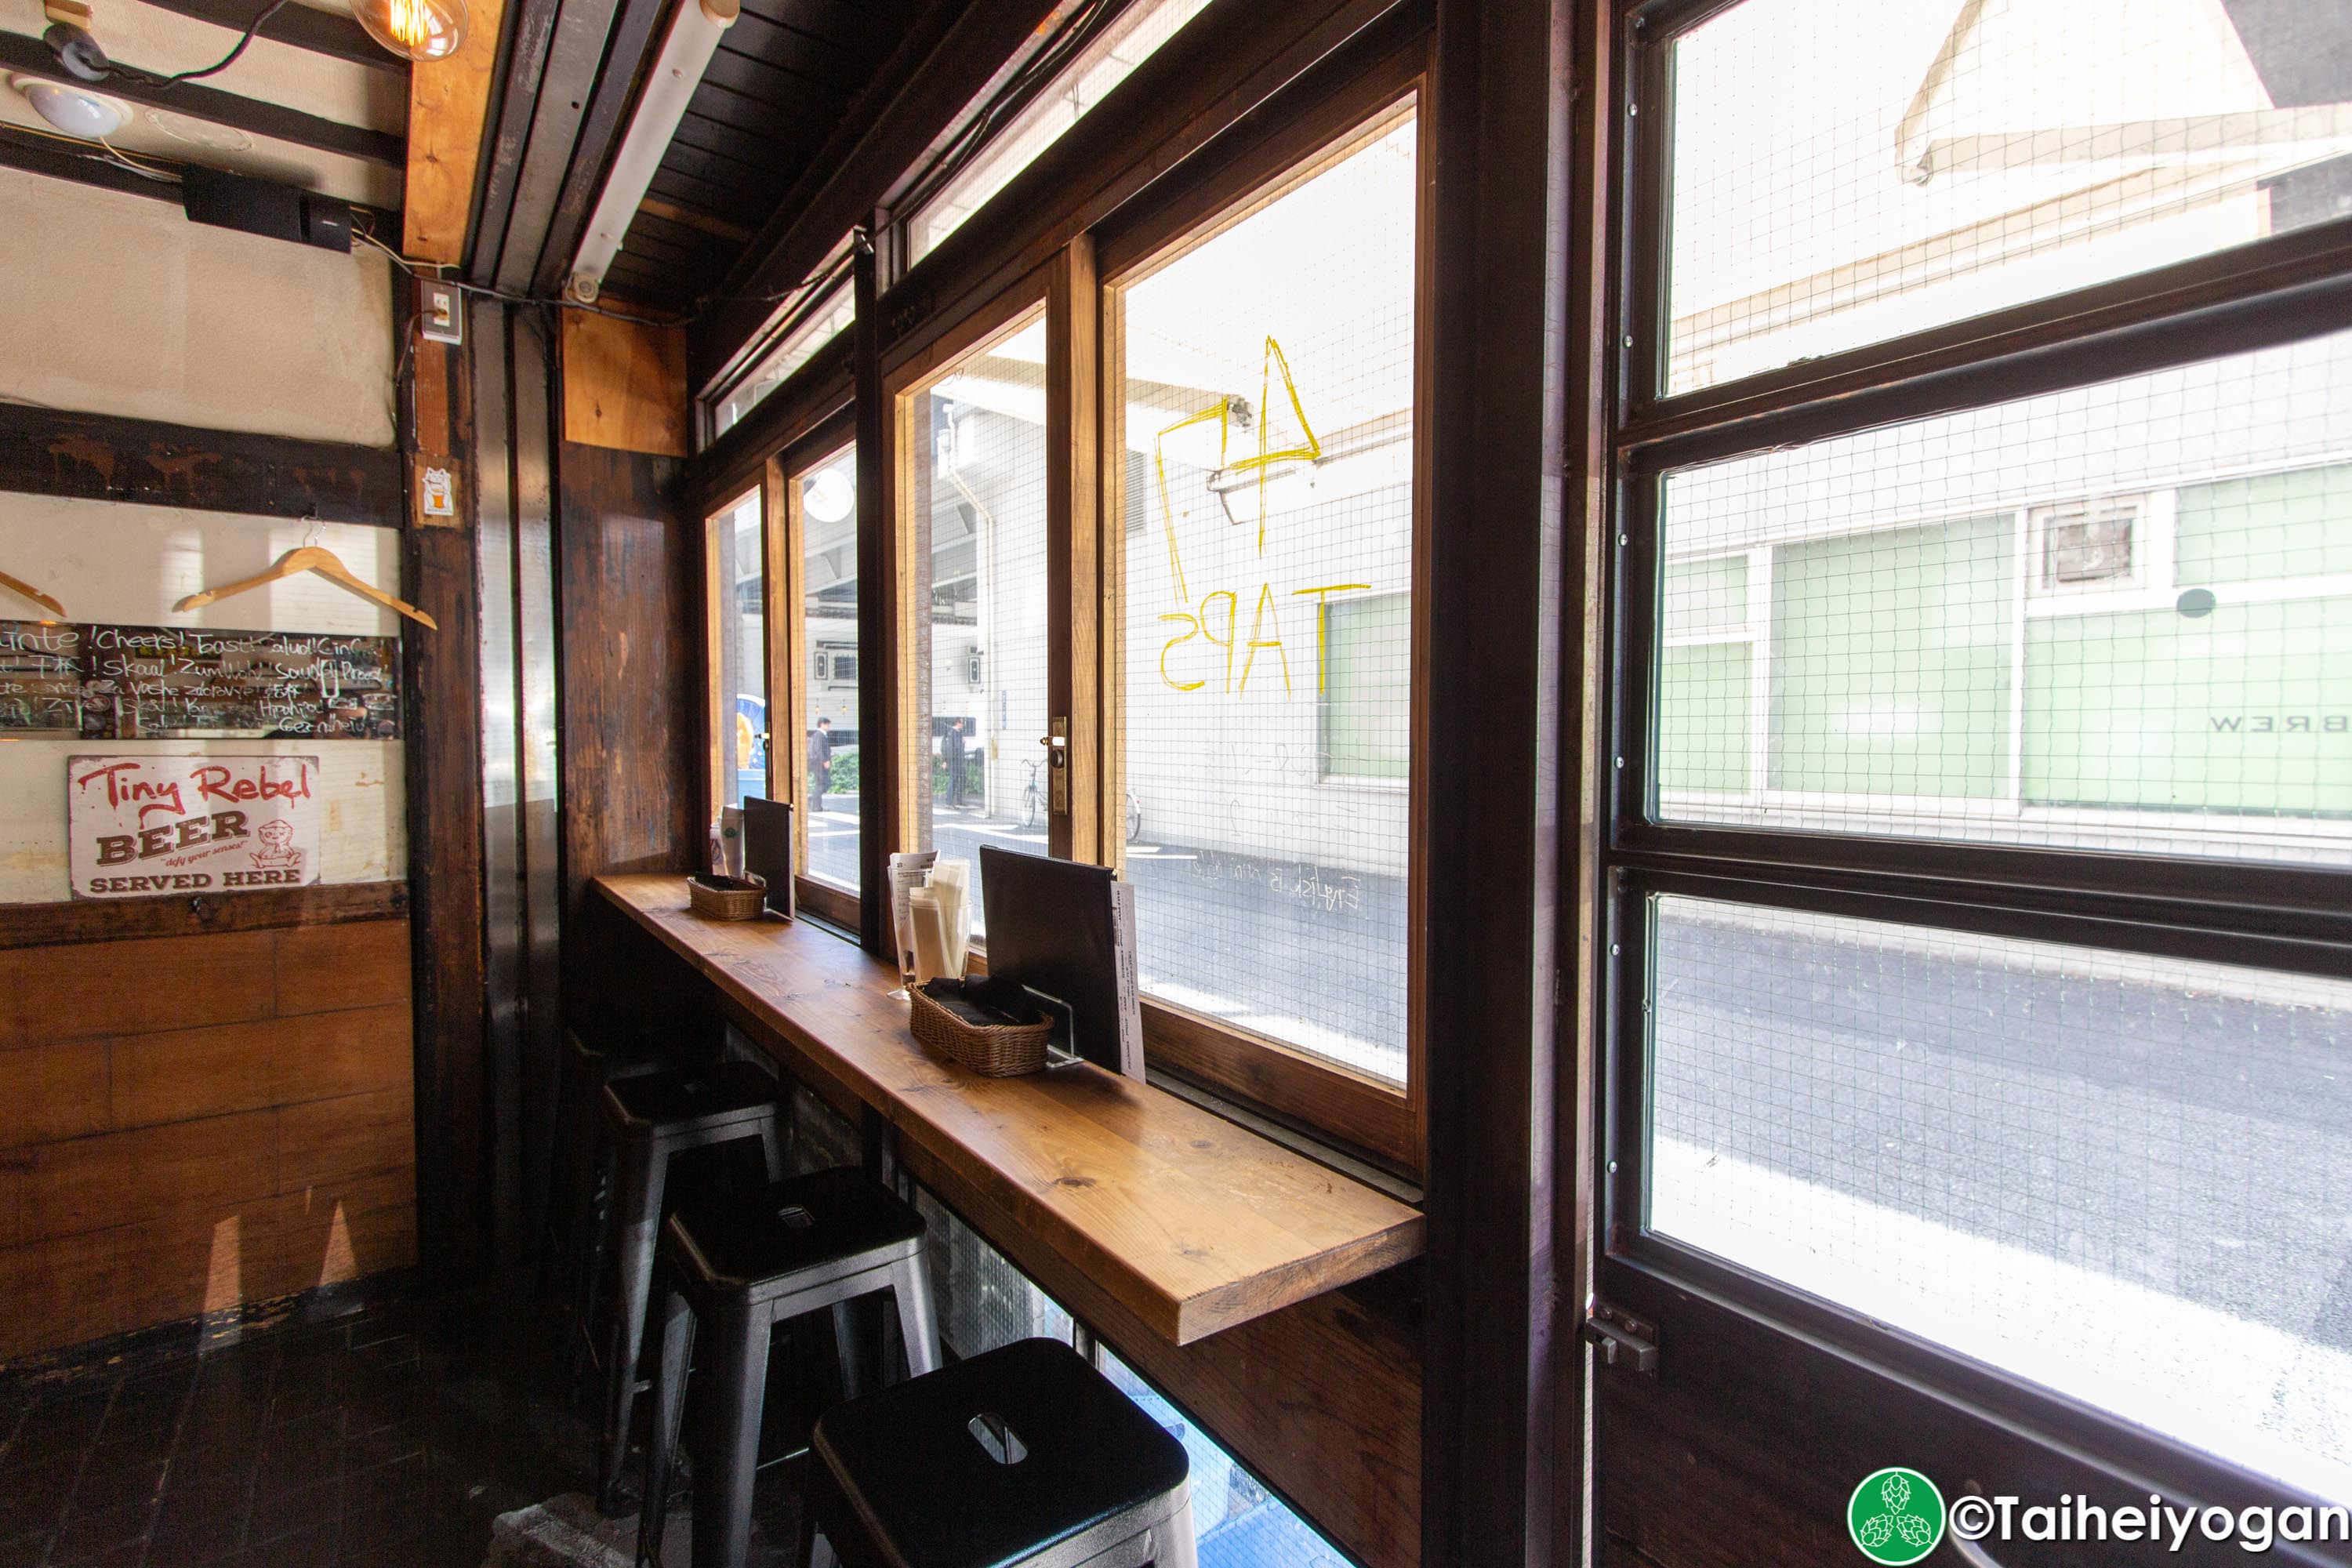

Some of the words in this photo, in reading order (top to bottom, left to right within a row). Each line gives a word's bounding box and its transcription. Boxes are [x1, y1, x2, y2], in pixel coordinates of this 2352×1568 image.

[78, 763, 186, 828] Tiny
[190, 764, 312, 809] Rebel
[96, 810, 251, 867] BEER
[90, 873, 213, 895] SERVED
[223, 869, 301, 889] HERE
